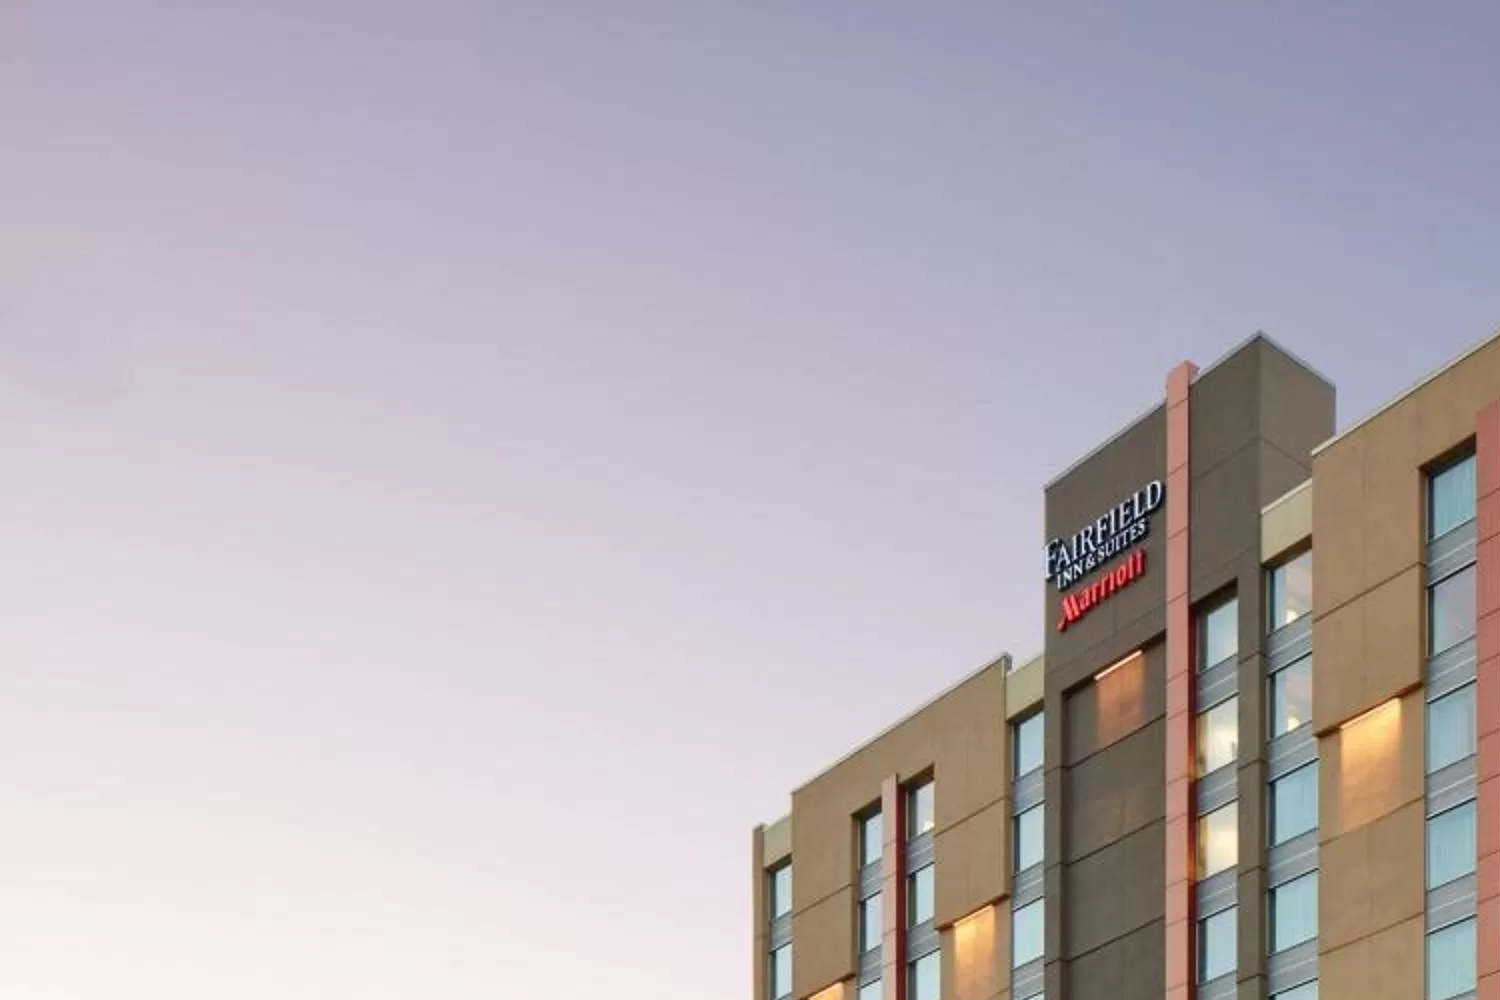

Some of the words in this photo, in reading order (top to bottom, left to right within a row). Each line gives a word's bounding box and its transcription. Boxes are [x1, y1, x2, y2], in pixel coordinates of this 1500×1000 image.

[1043, 479, 1164, 580] FAIRFIELD
[1057, 557, 1084, 589] INN
[1085, 551, 1097, 571] &
[1097, 517, 1147, 565] SUITES
[1056, 549, 1146, 633] Marriott
